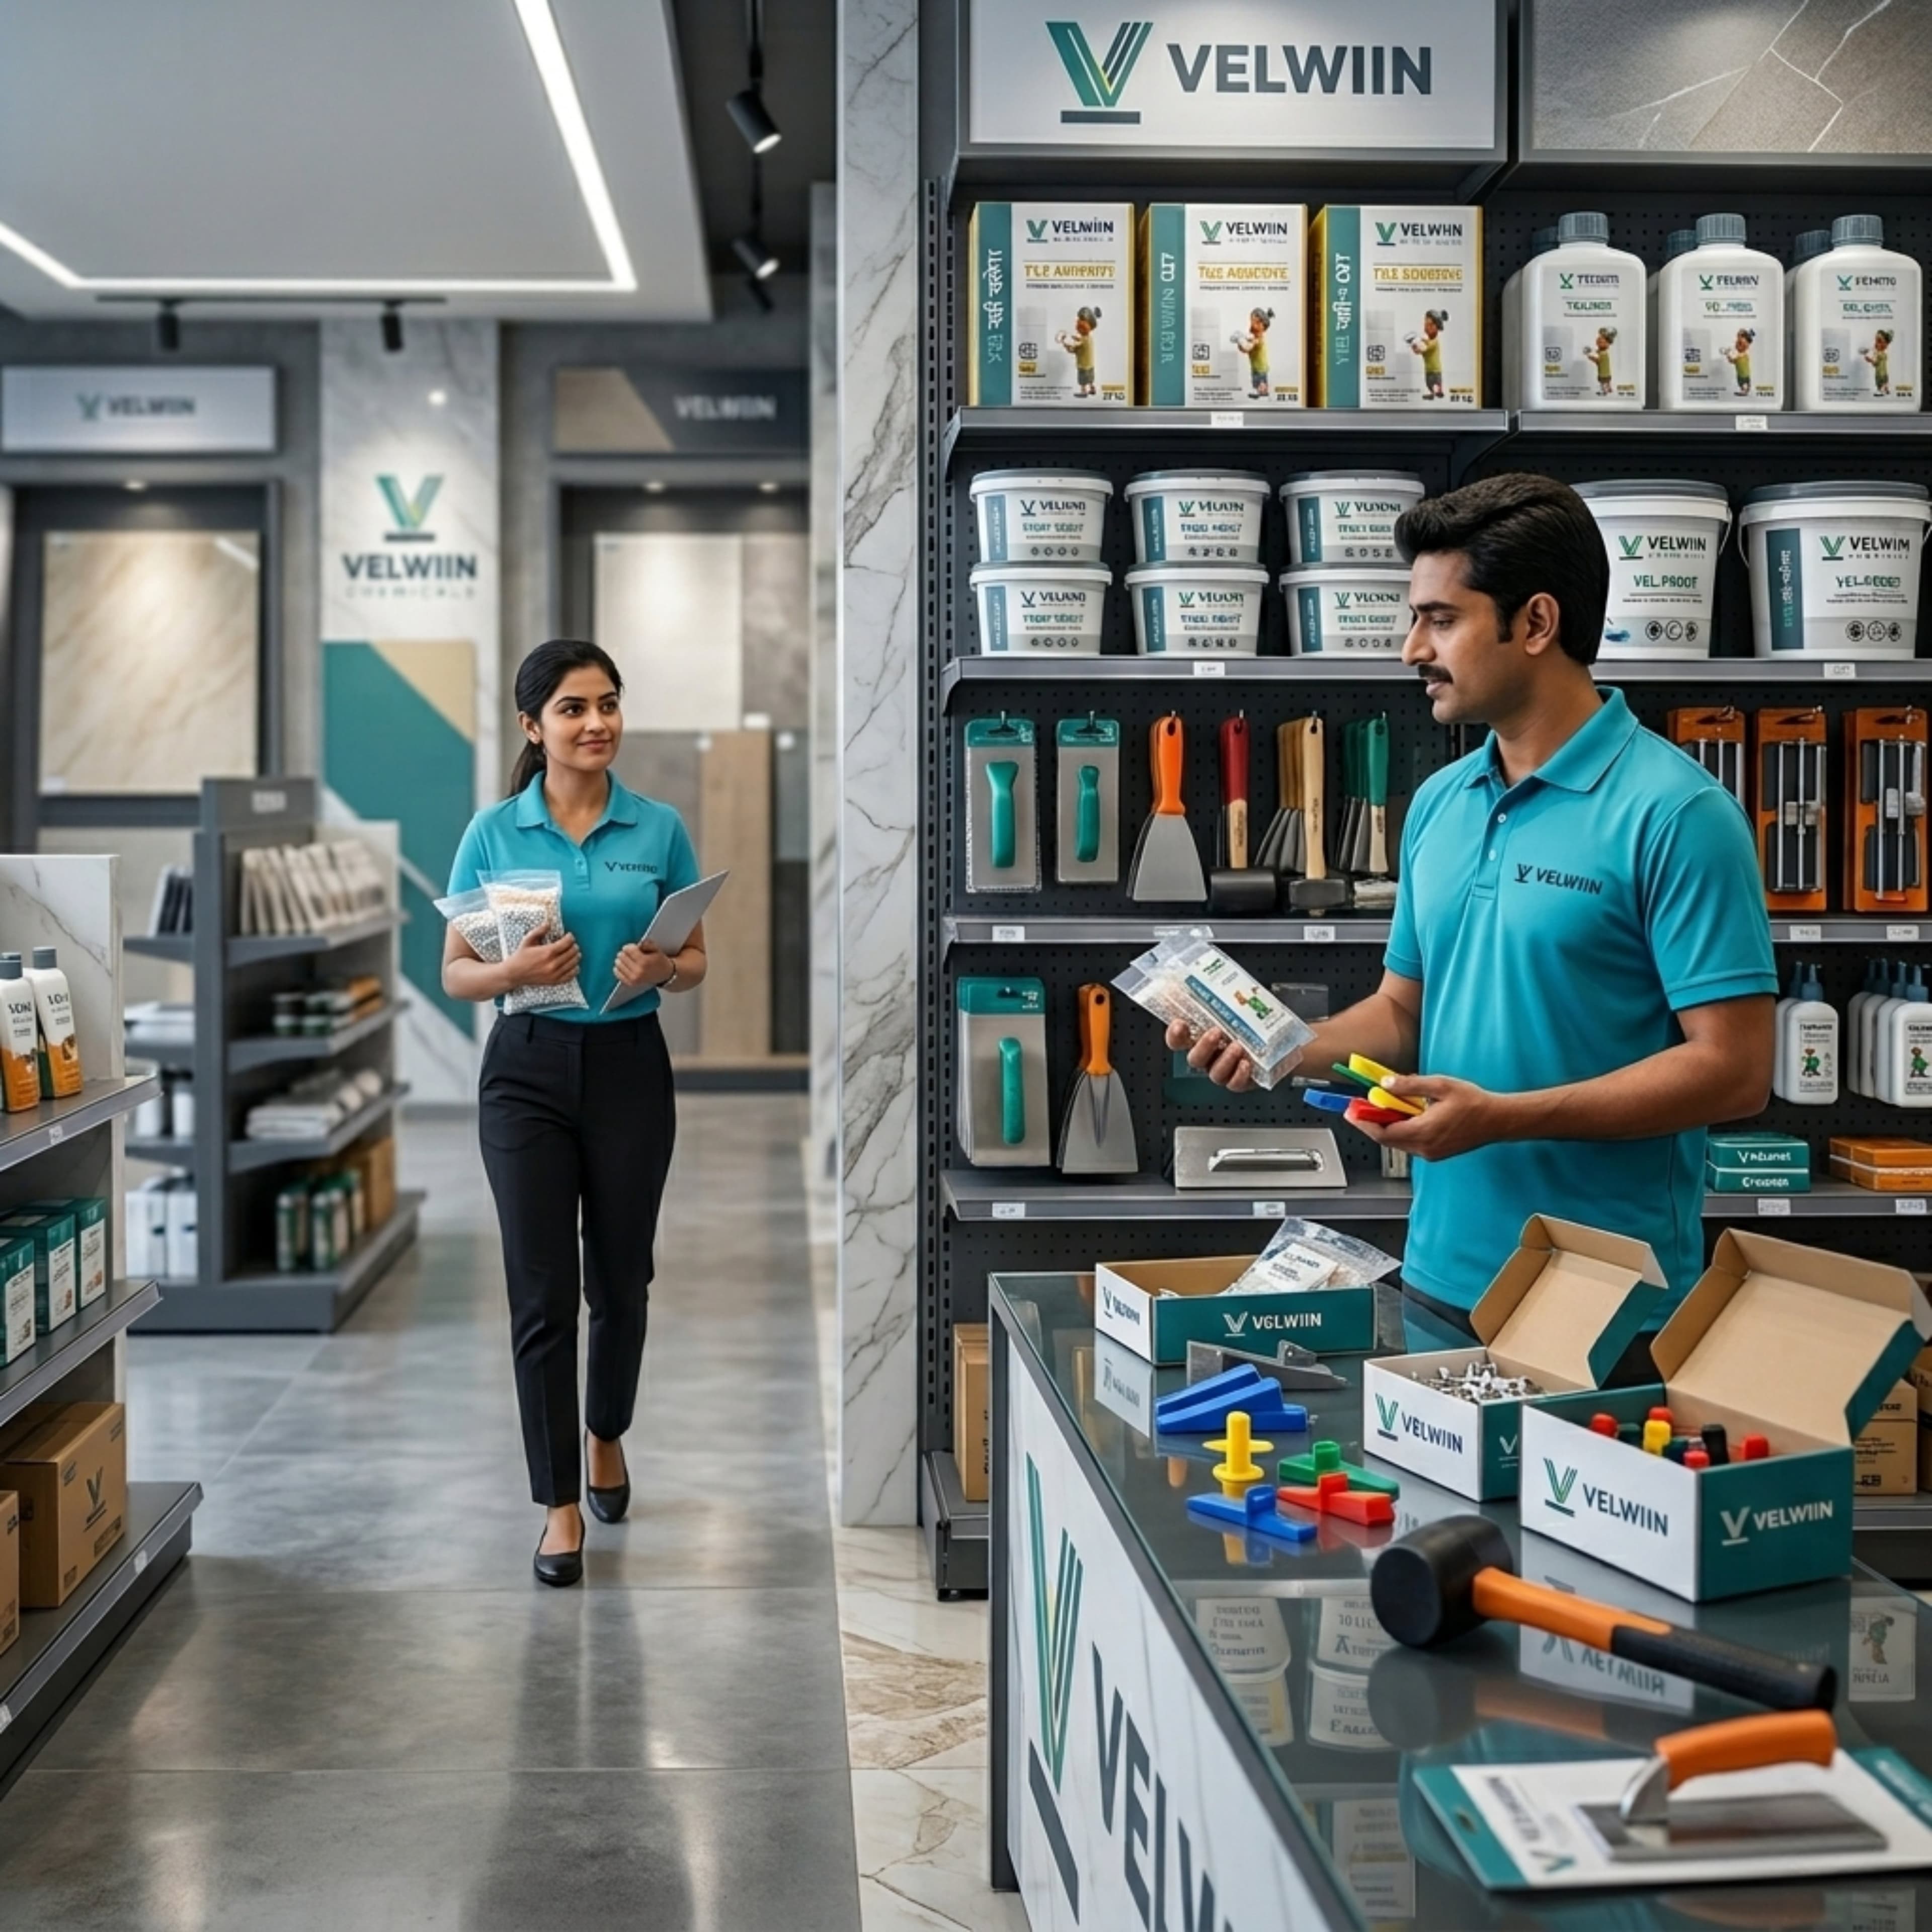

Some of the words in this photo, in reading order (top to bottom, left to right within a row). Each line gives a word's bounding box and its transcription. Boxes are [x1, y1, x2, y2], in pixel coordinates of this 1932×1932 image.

[1167, 44, 1432, 95] VELWIIN
[1647, 535, 1706, 551] VELWIIN
[342, 554, 477, 579] VELWIIN
[1537, 867, 1603, 895] VELWIIN
[1402, 1411, 1463, 1454] VELWIIN
[1583, 1484, 1669, 1537] VELWIIN
[1753, 1501, 1833, 1531] VELWIIN
